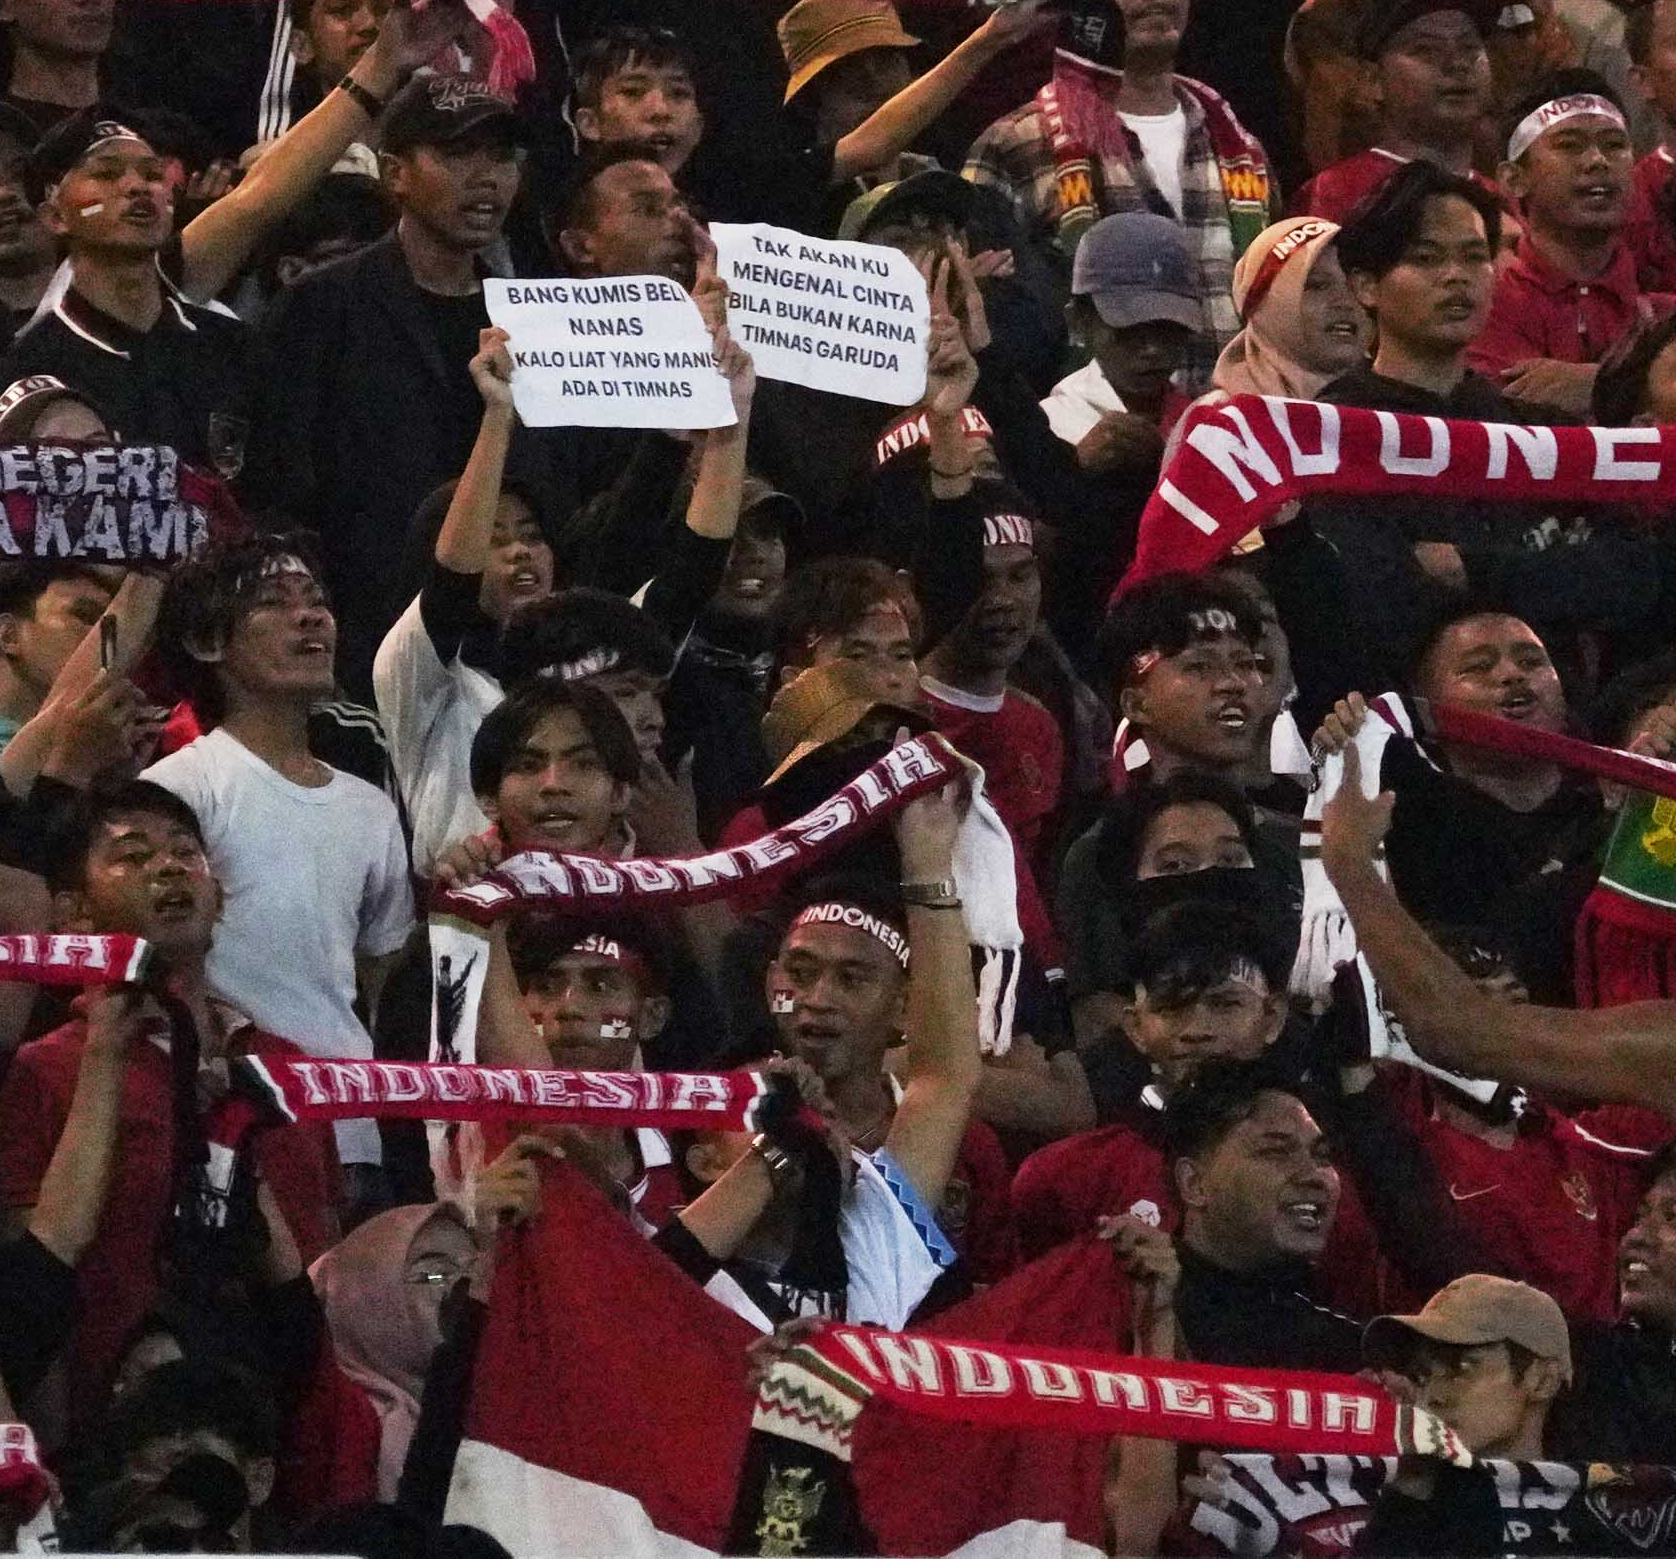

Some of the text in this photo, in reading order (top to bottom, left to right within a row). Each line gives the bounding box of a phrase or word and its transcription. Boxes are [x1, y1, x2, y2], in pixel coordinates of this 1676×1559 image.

[751, 235, 891, 278] TAK AKAN KU
[507, 285, 573, 307] BANG
[574, 284, 642, 306] KUMIS
[732, 261, 915, 313] MENGENAL CINTA
[569, 316, 644, 338] NANAS
[728, 291, 917, 345] BILA BUKAN KARNA
[516, 351, 722, 370] KALO LIAT YANG MANIS
[742, 323, 901, 373] TIMNAS GARUDA
[561, 379, 694, 399] ADA DI TIMNAS
[446, 739, 947, 909] INDONESIA
[801, 903, 912, 969] INDONESIA
[292, 1060, 732, 1110] INDONESIA
[832, 1328, 1378, 1435] INDONESIA
